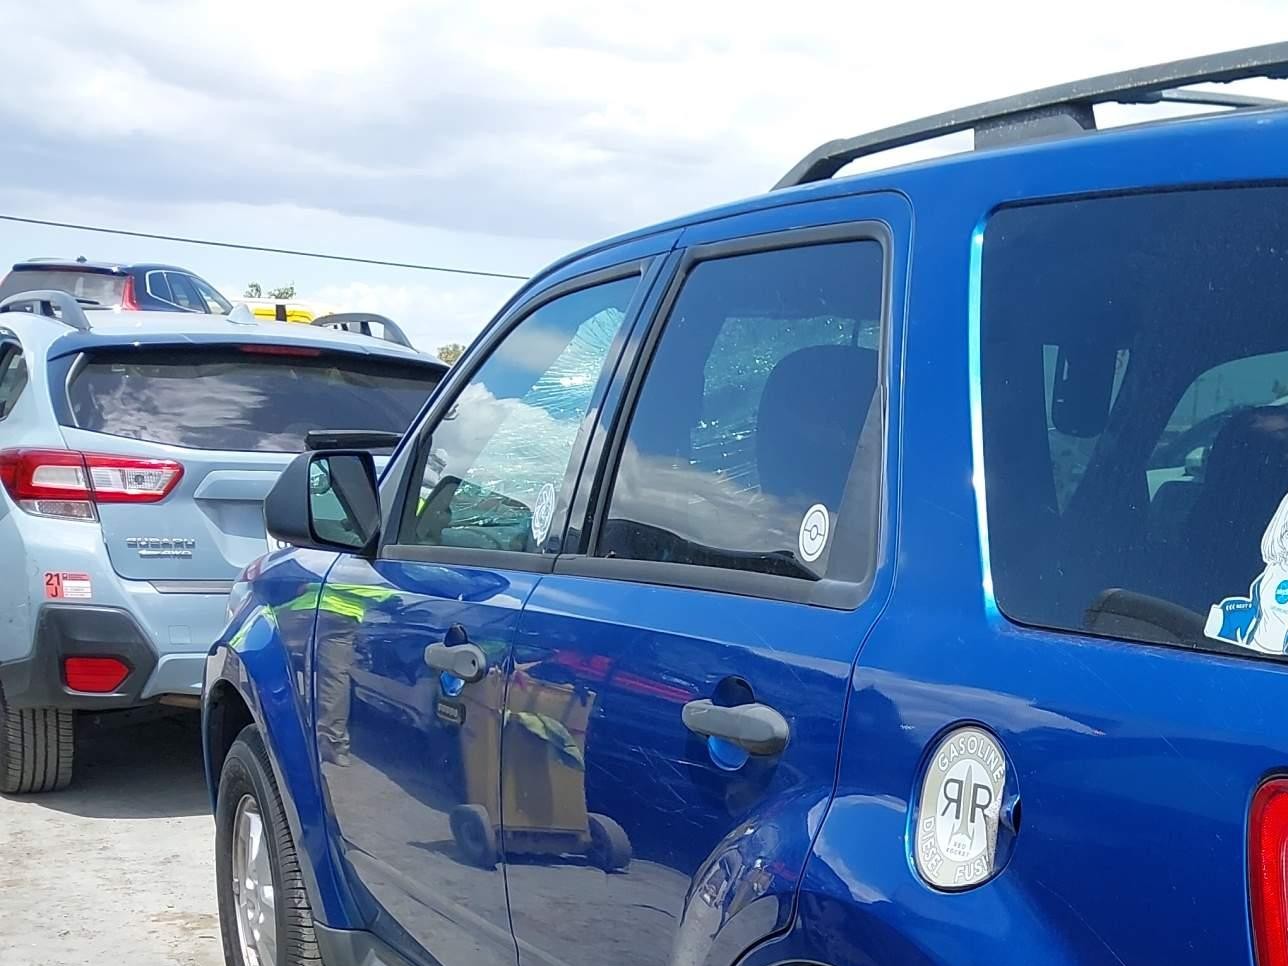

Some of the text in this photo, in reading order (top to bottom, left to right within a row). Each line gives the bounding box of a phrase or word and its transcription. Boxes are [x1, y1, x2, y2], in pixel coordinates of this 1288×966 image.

[126, 537, 195, 548] SUBARU
[45, 573, 60, 586] 21
[51, 587, 59, 598] J
[937, 736, 1005, 783] GASOLINE
[923, 816, 944, 879] DIESEL
